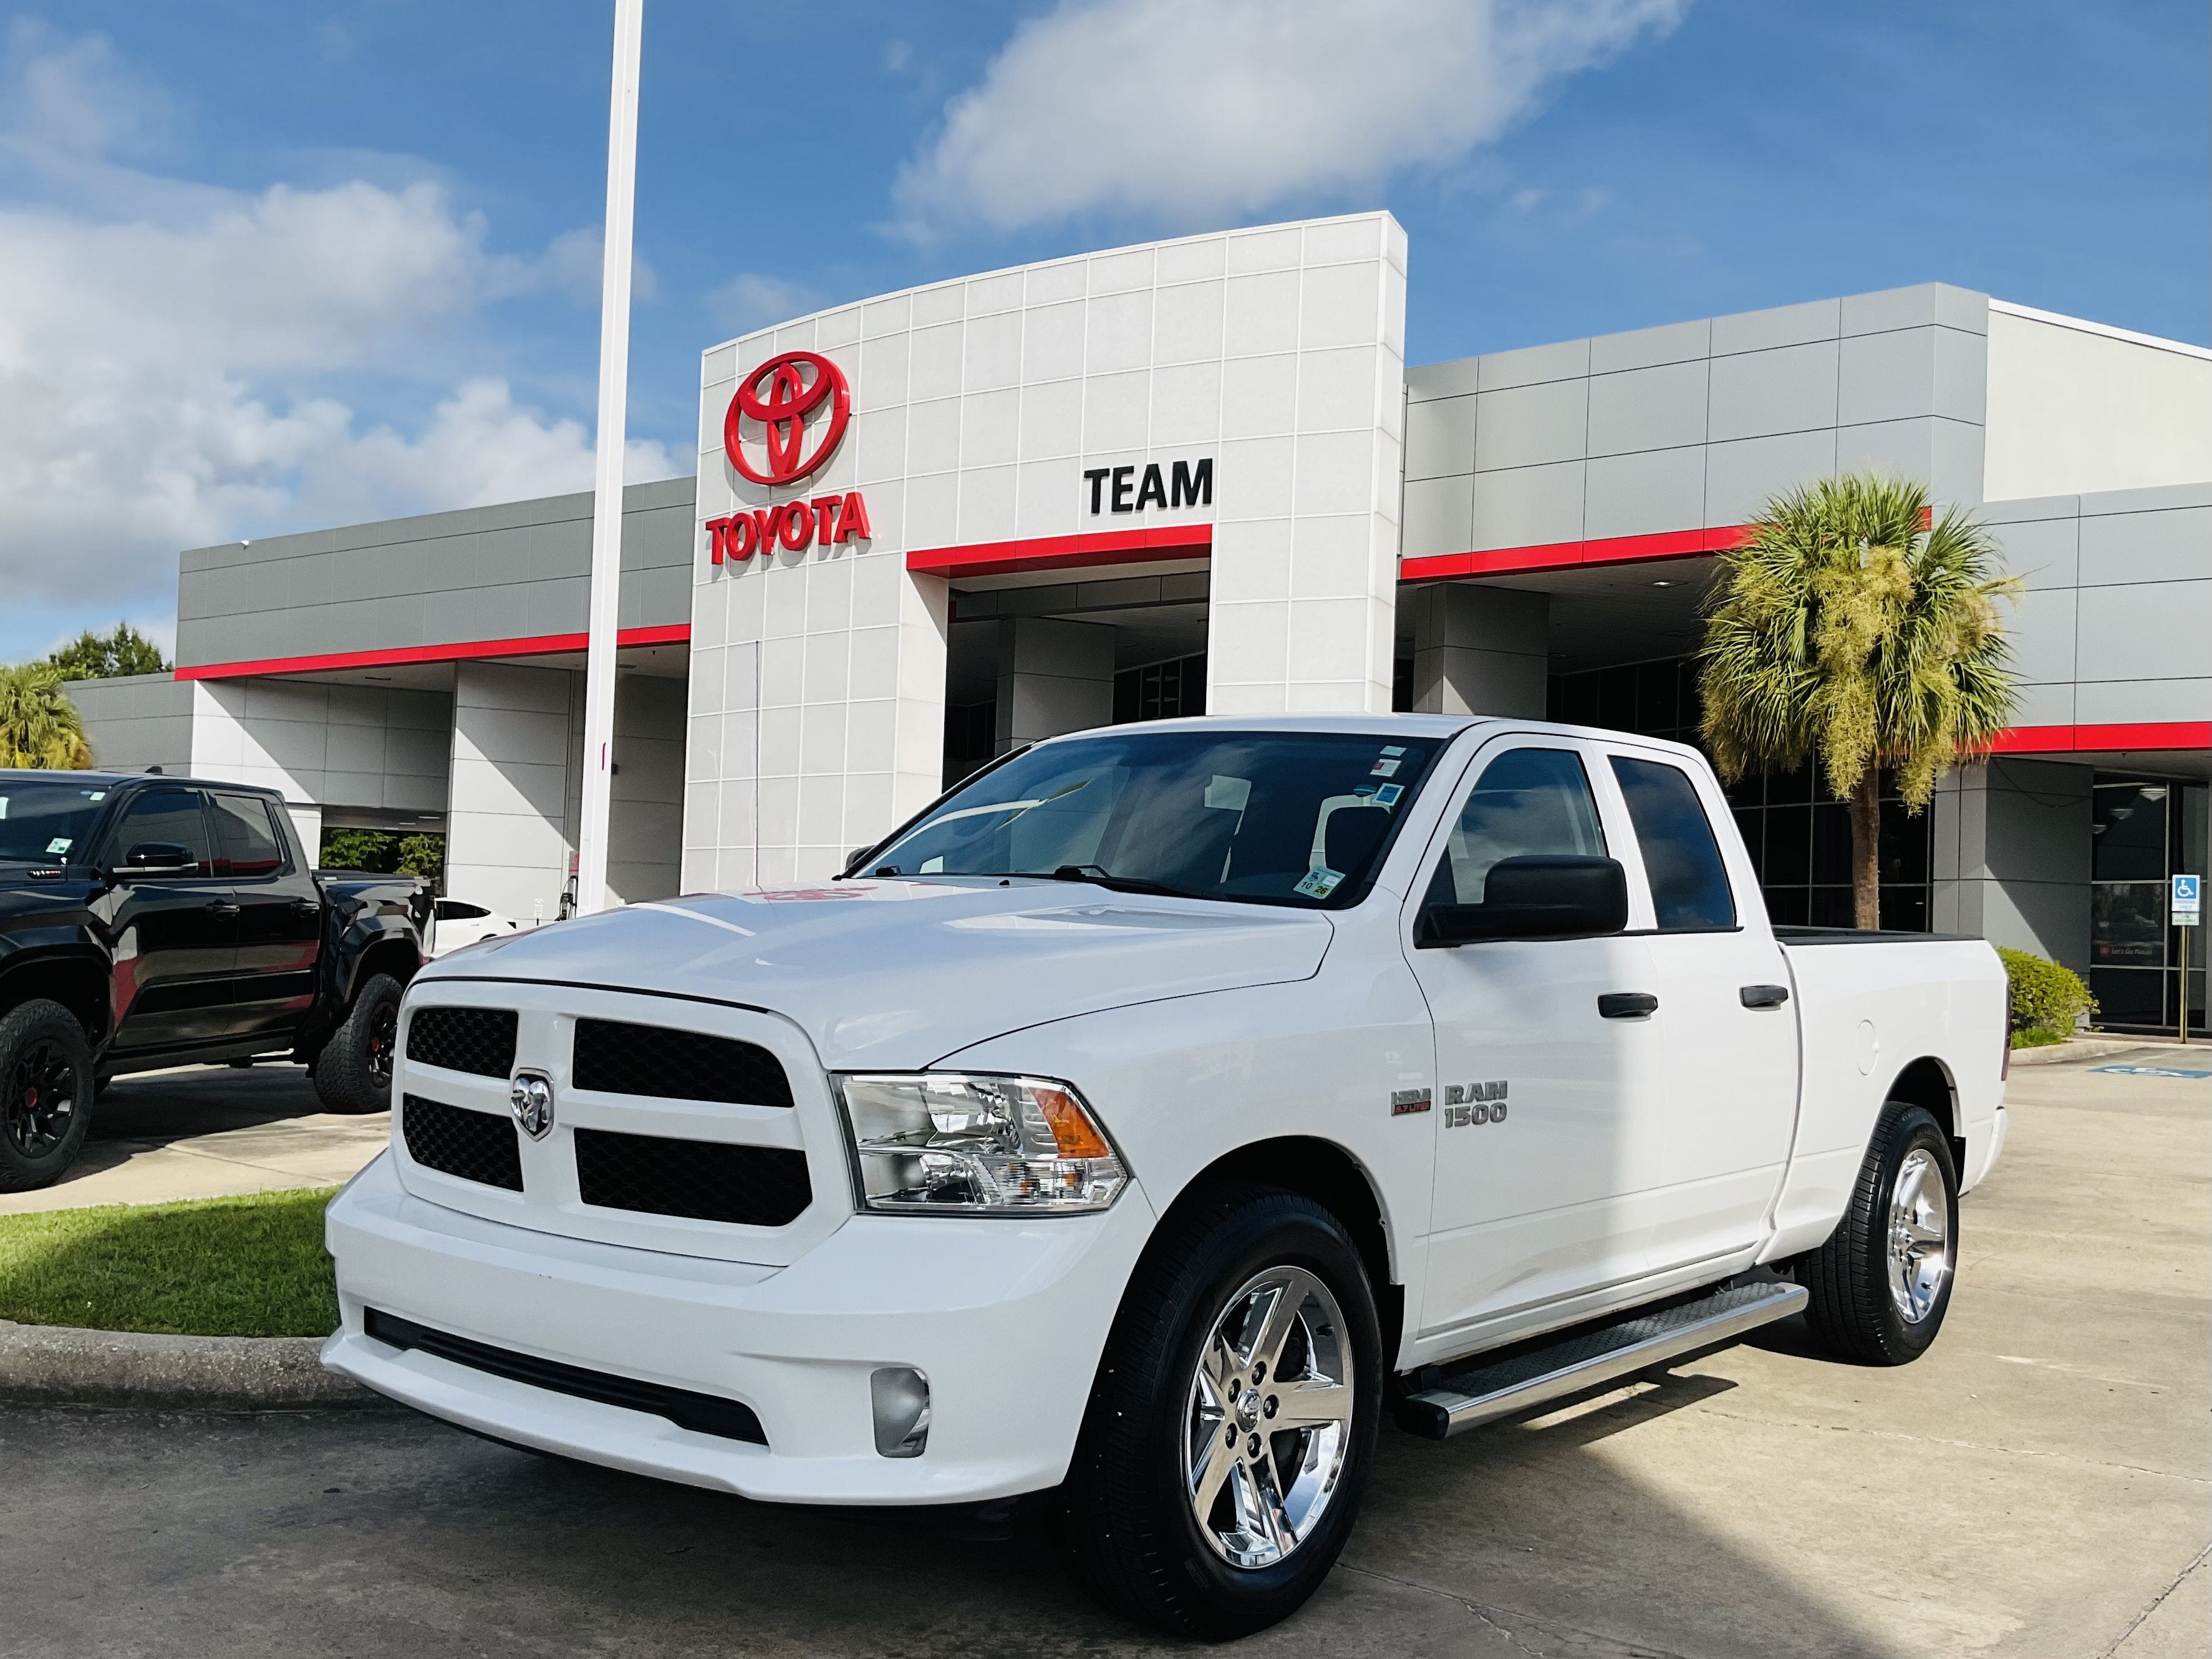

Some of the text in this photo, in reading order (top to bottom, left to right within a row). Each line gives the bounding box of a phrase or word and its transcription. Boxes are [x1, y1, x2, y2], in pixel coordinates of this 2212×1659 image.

[1084, 458, 1213, 514] TEAM
[705, 491, 871, 565] TOYOTA
[1301, 881, 1328, 894] 10 26
[1444, 1080, 1508, 1105] RAM
[1444, 1102, 1507, 1128] 1500
